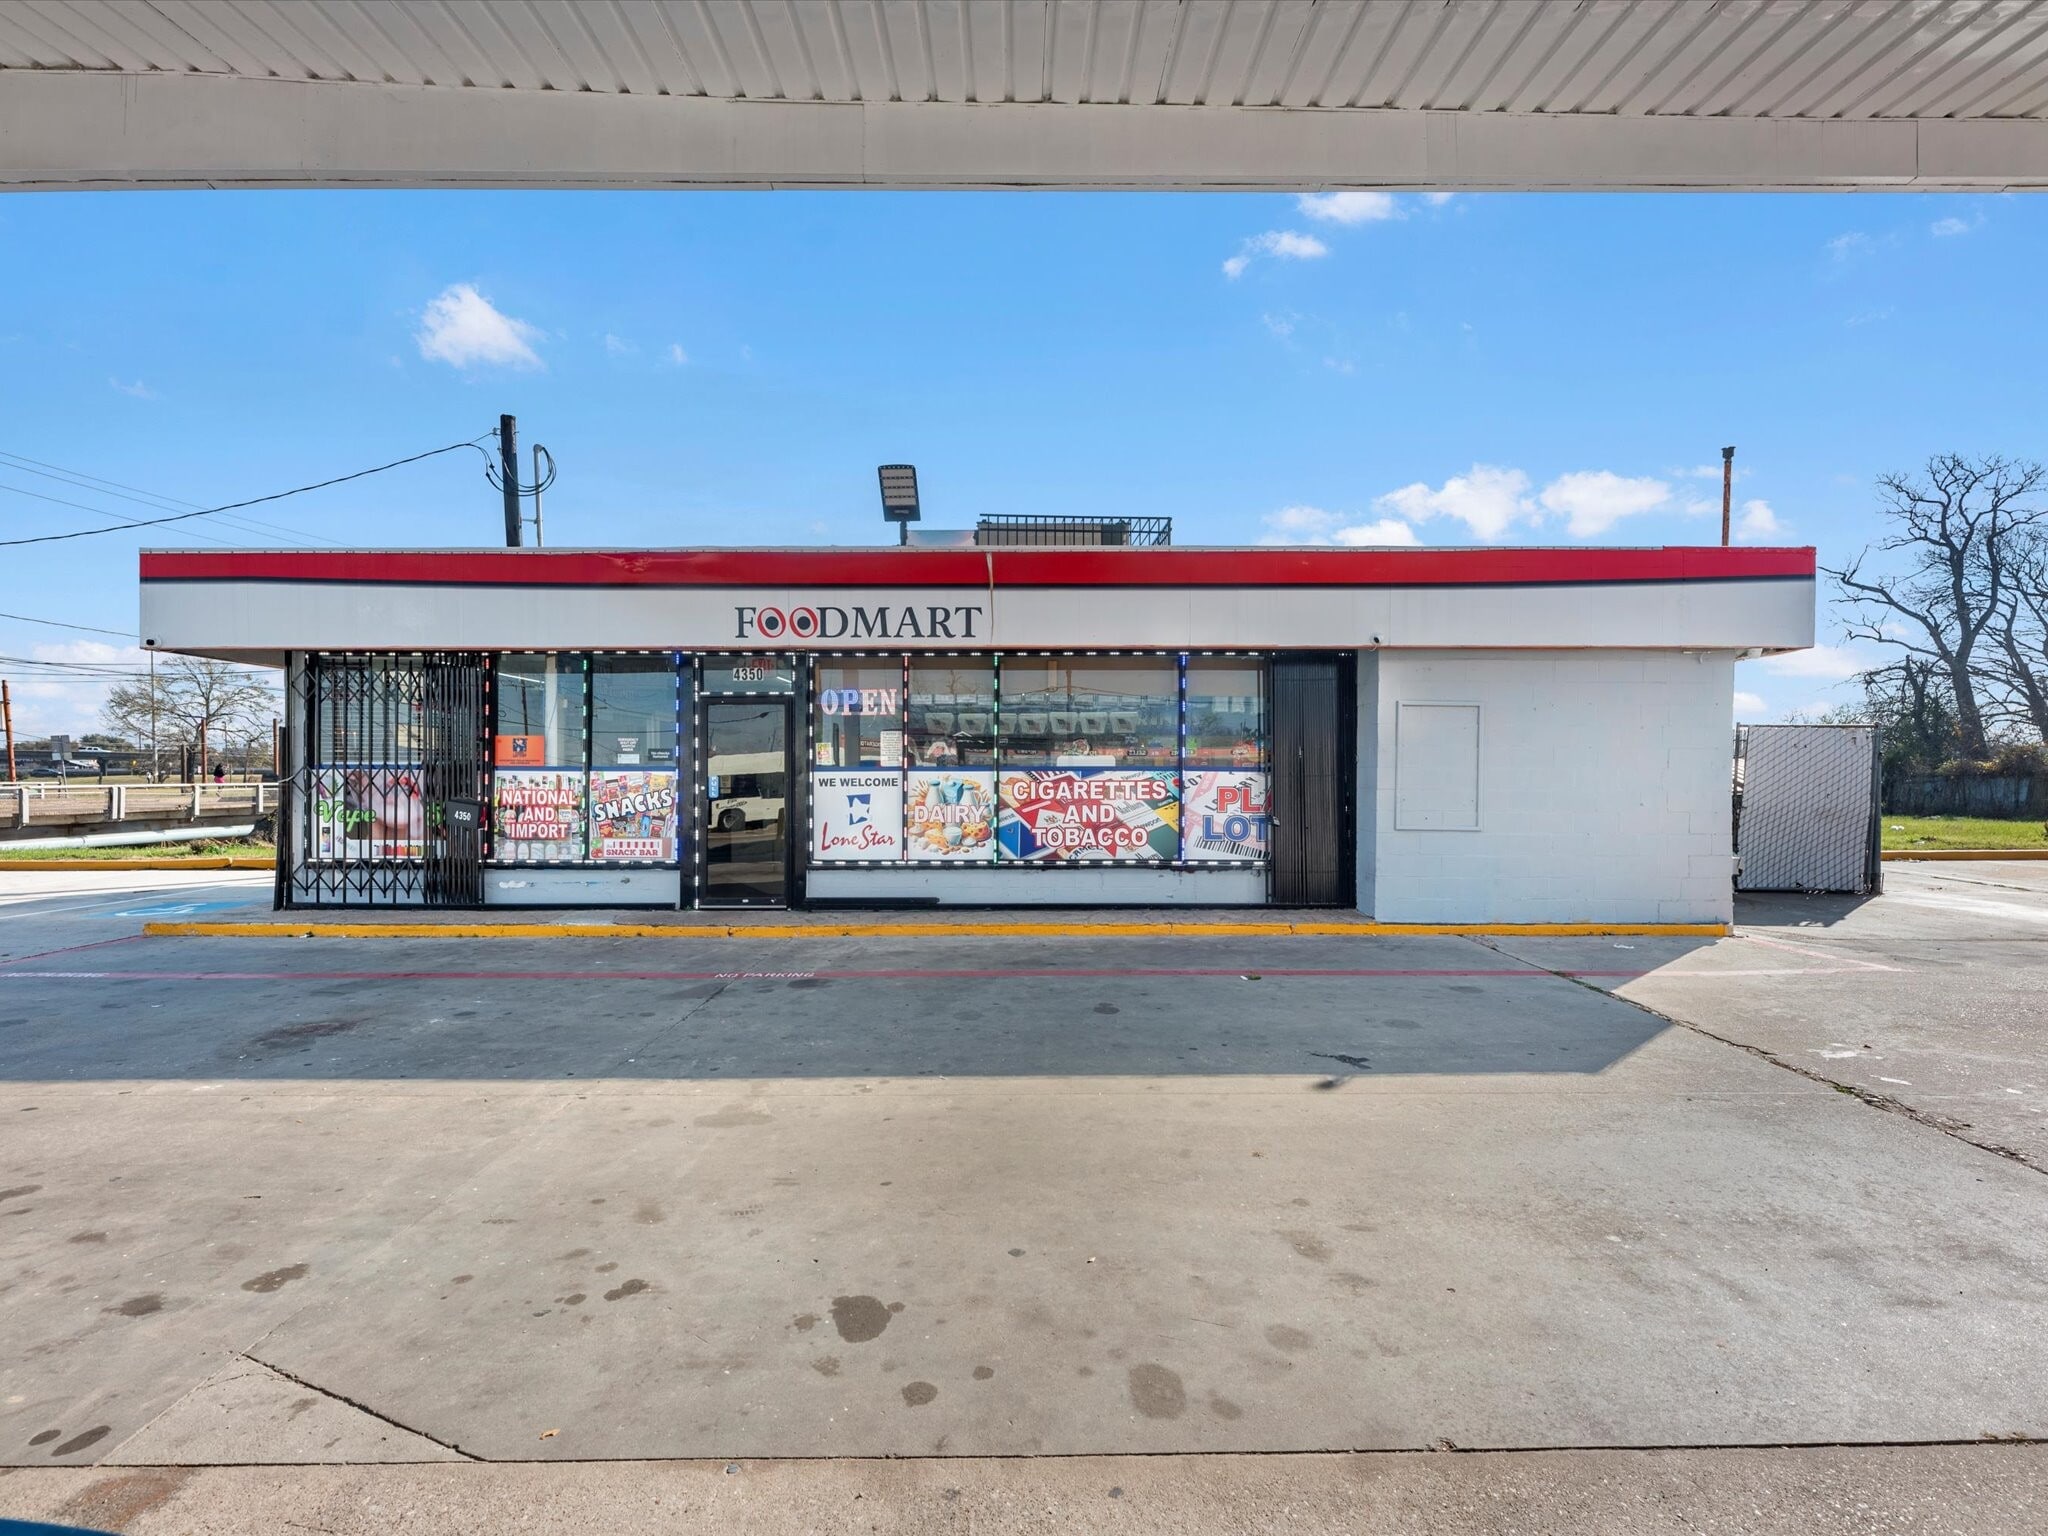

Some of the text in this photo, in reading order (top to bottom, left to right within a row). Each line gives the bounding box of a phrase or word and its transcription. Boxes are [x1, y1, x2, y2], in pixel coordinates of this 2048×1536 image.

[734, 606, 982, 638] FOODMART
[733, 667, 763, 680] 4350
[820, 688, 897, 716] OPEN
[818, 778, 898, 787] WE WELCOME
[1013, 780, 1167, 800] CIGARETTES
[501, 789, 577, 806] NATIONAL
[594, 788, 673, 822] SNACKS
[313, 800, 377, 832] Vape
[454, 810, 471, 821] 4350
[523, 806, 555, 822] AND
[914, 804, 986, 824] DAIRY
[1063, 804, 1116, 823] AND
[510, 823, 568, 839] IMPORT
[821, 822, 895, 851] Lone Star
[1031, 827, 1148, 847] TOBACCO
